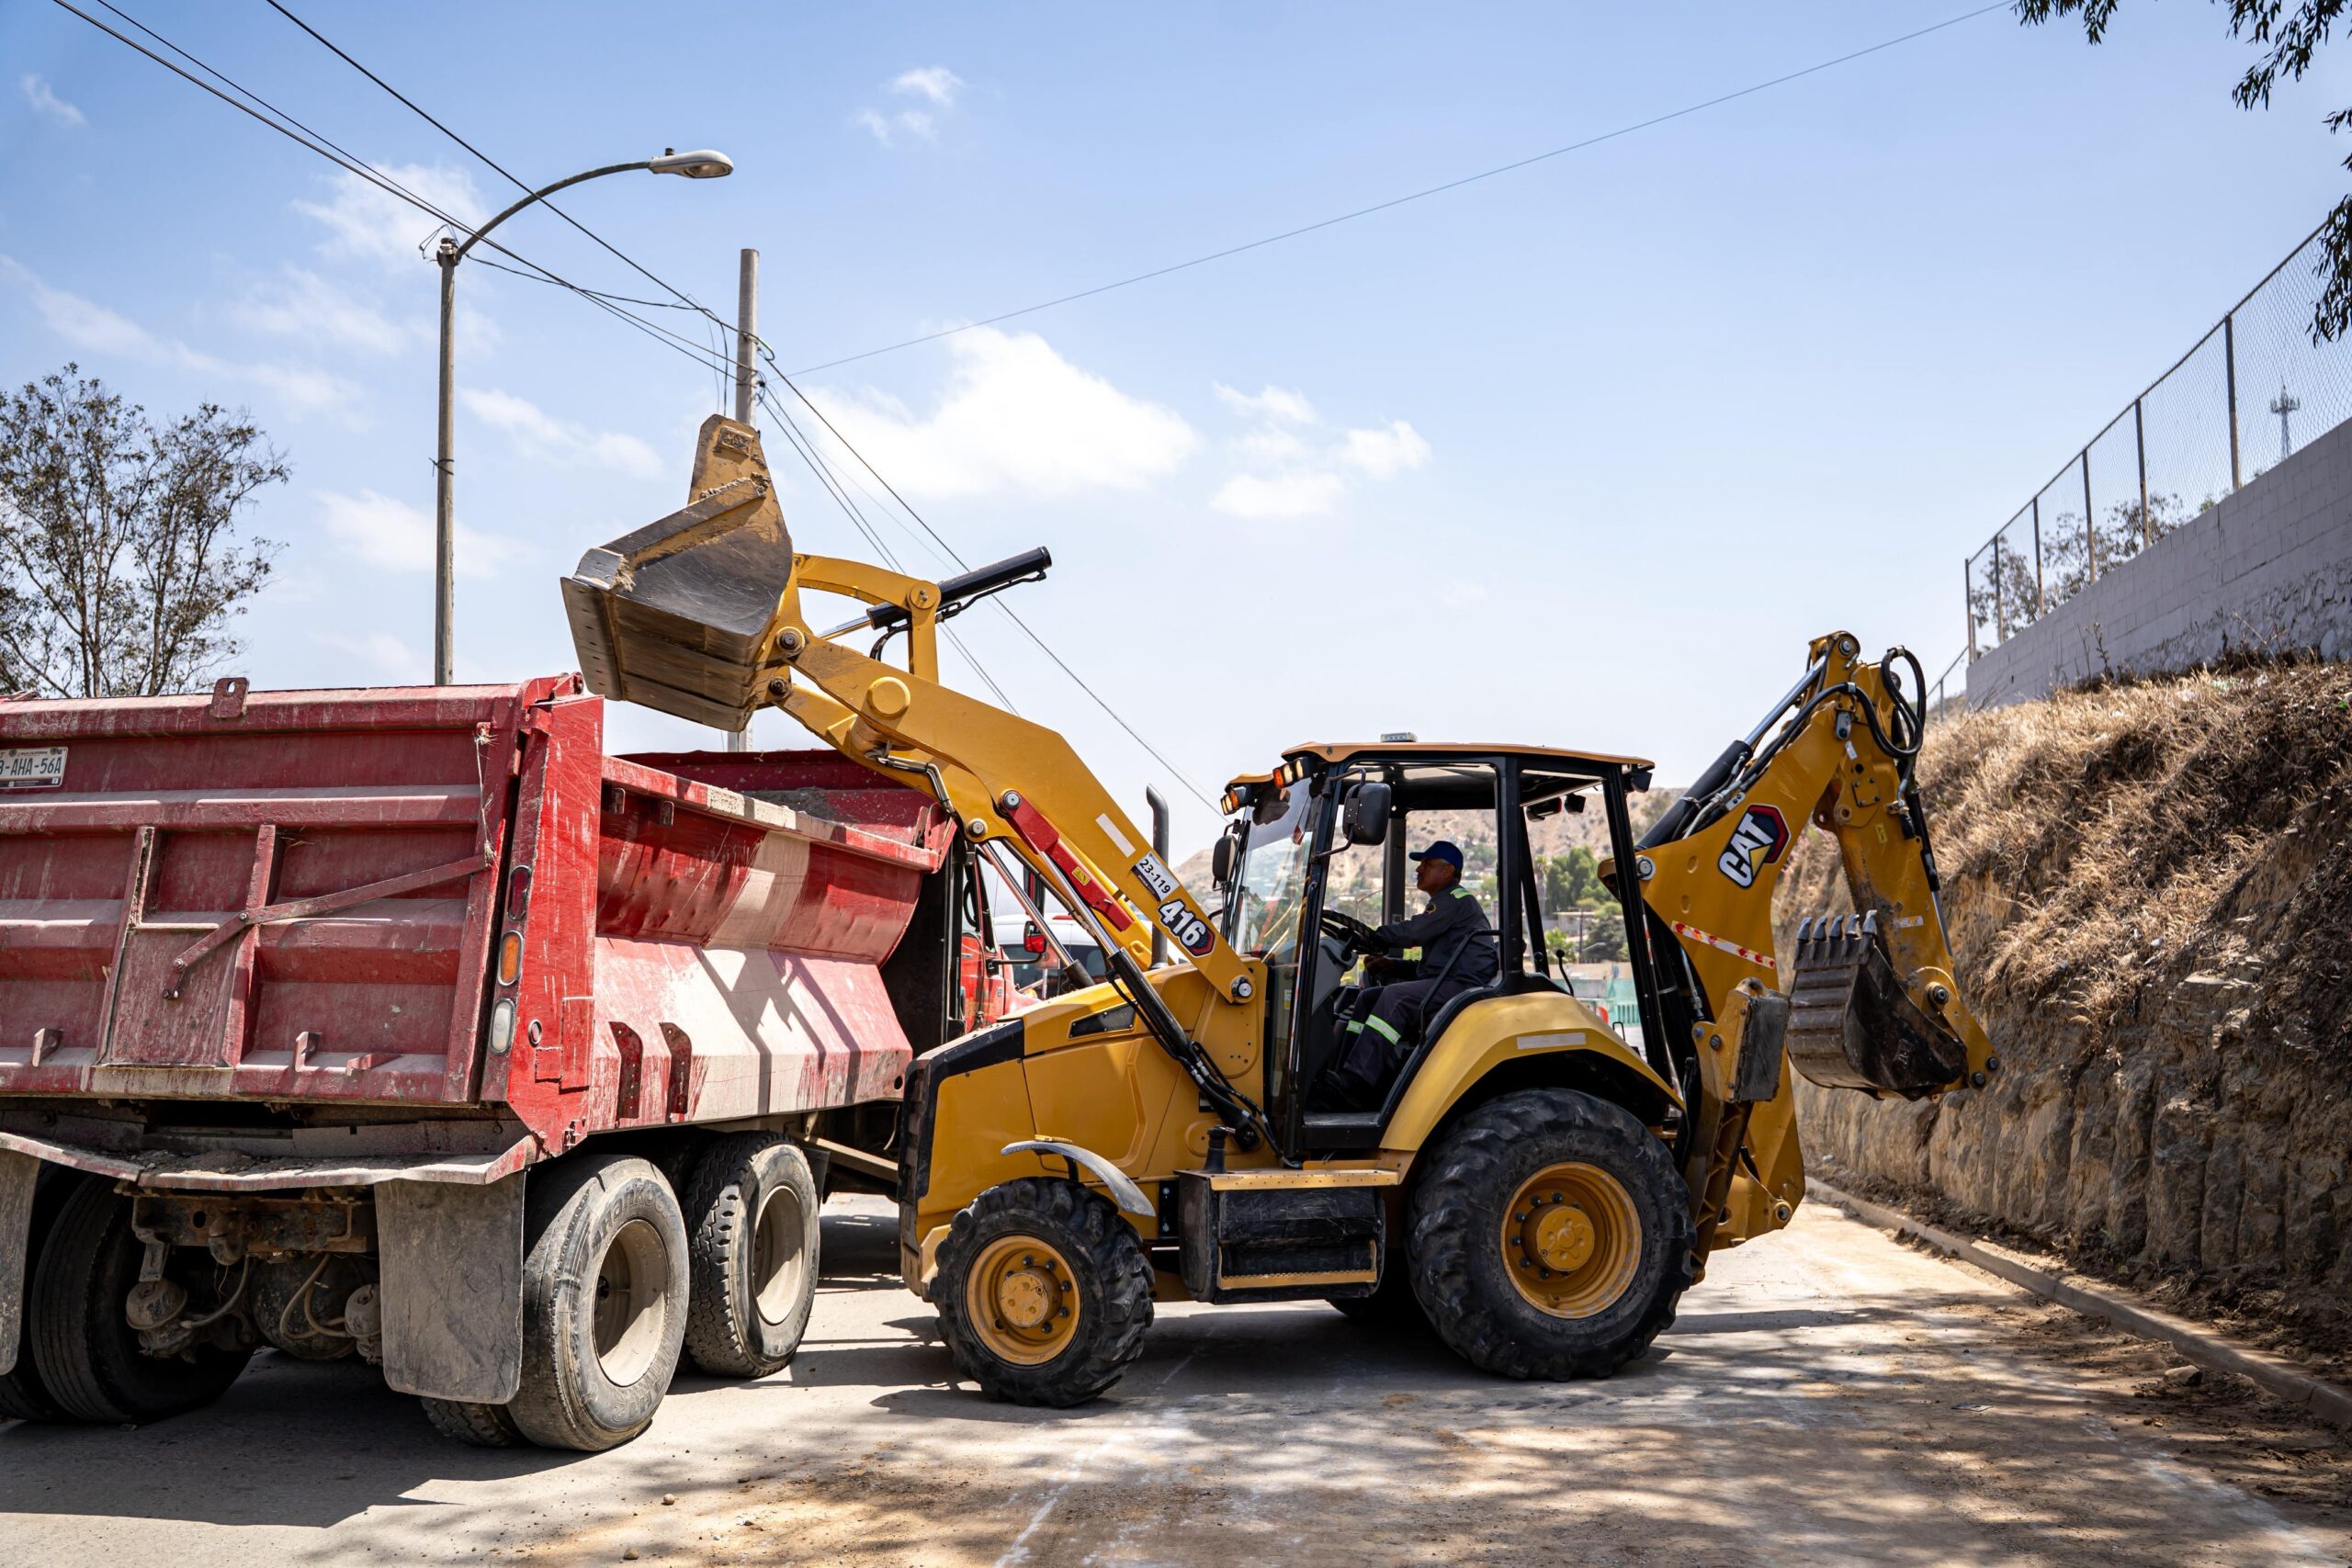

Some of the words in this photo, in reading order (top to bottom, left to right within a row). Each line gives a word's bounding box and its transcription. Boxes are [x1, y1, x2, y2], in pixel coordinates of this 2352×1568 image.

[1719, 812, 1774, 887] CAT
[1139, 859, 1171, 894] 23-119
[1159, 899, 1206, 947] 416
